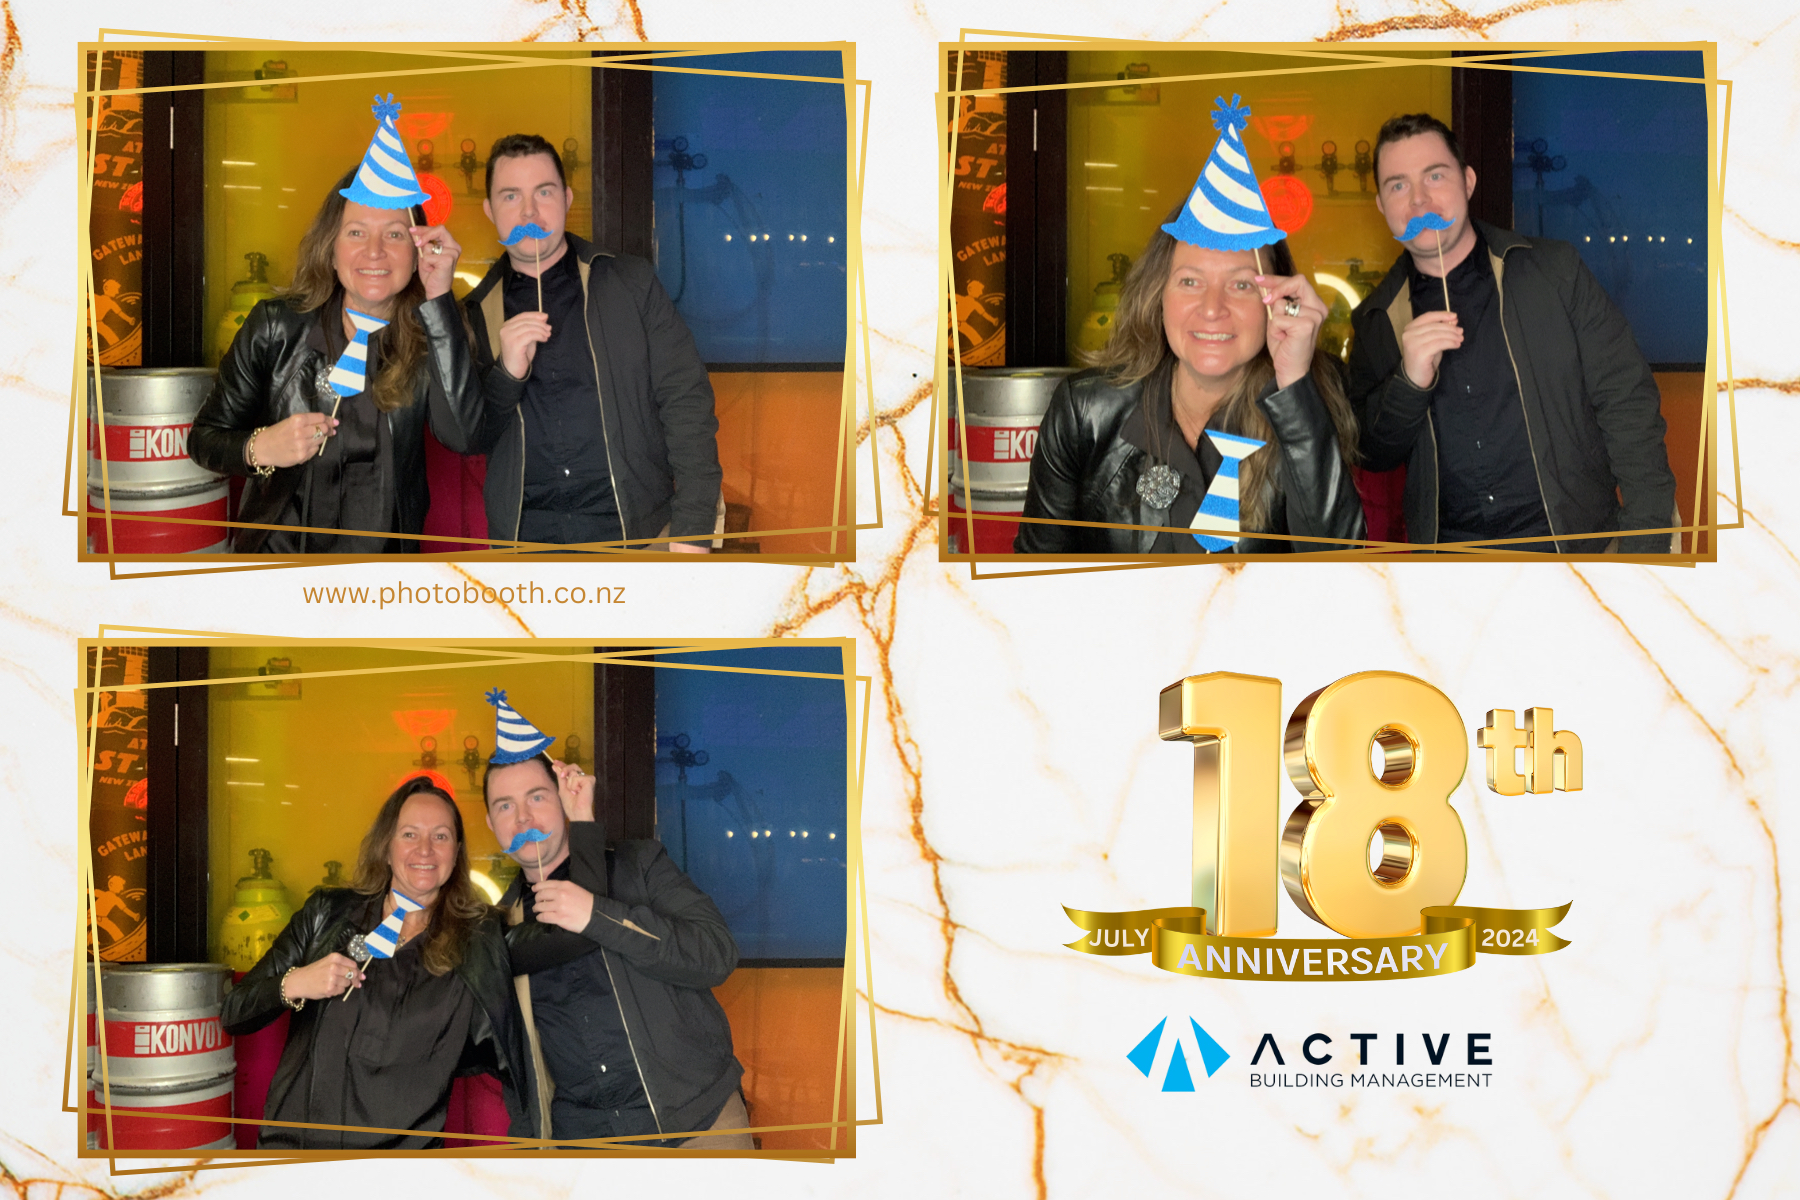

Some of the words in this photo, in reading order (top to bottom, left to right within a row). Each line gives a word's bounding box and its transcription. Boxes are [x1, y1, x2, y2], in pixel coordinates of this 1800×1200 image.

[87, 151, 134, 177] ST
[948, 152, 998, 178] ST
[94, 180, 119, 189] NEW
[958, 181, 983, 190] NEW
[146, 427, 191, 458] KON
[87, 746, 139, 773] ST
[99, 776, 124, 786] NEW
[151, 1020, 222, 1054] KONVOY
